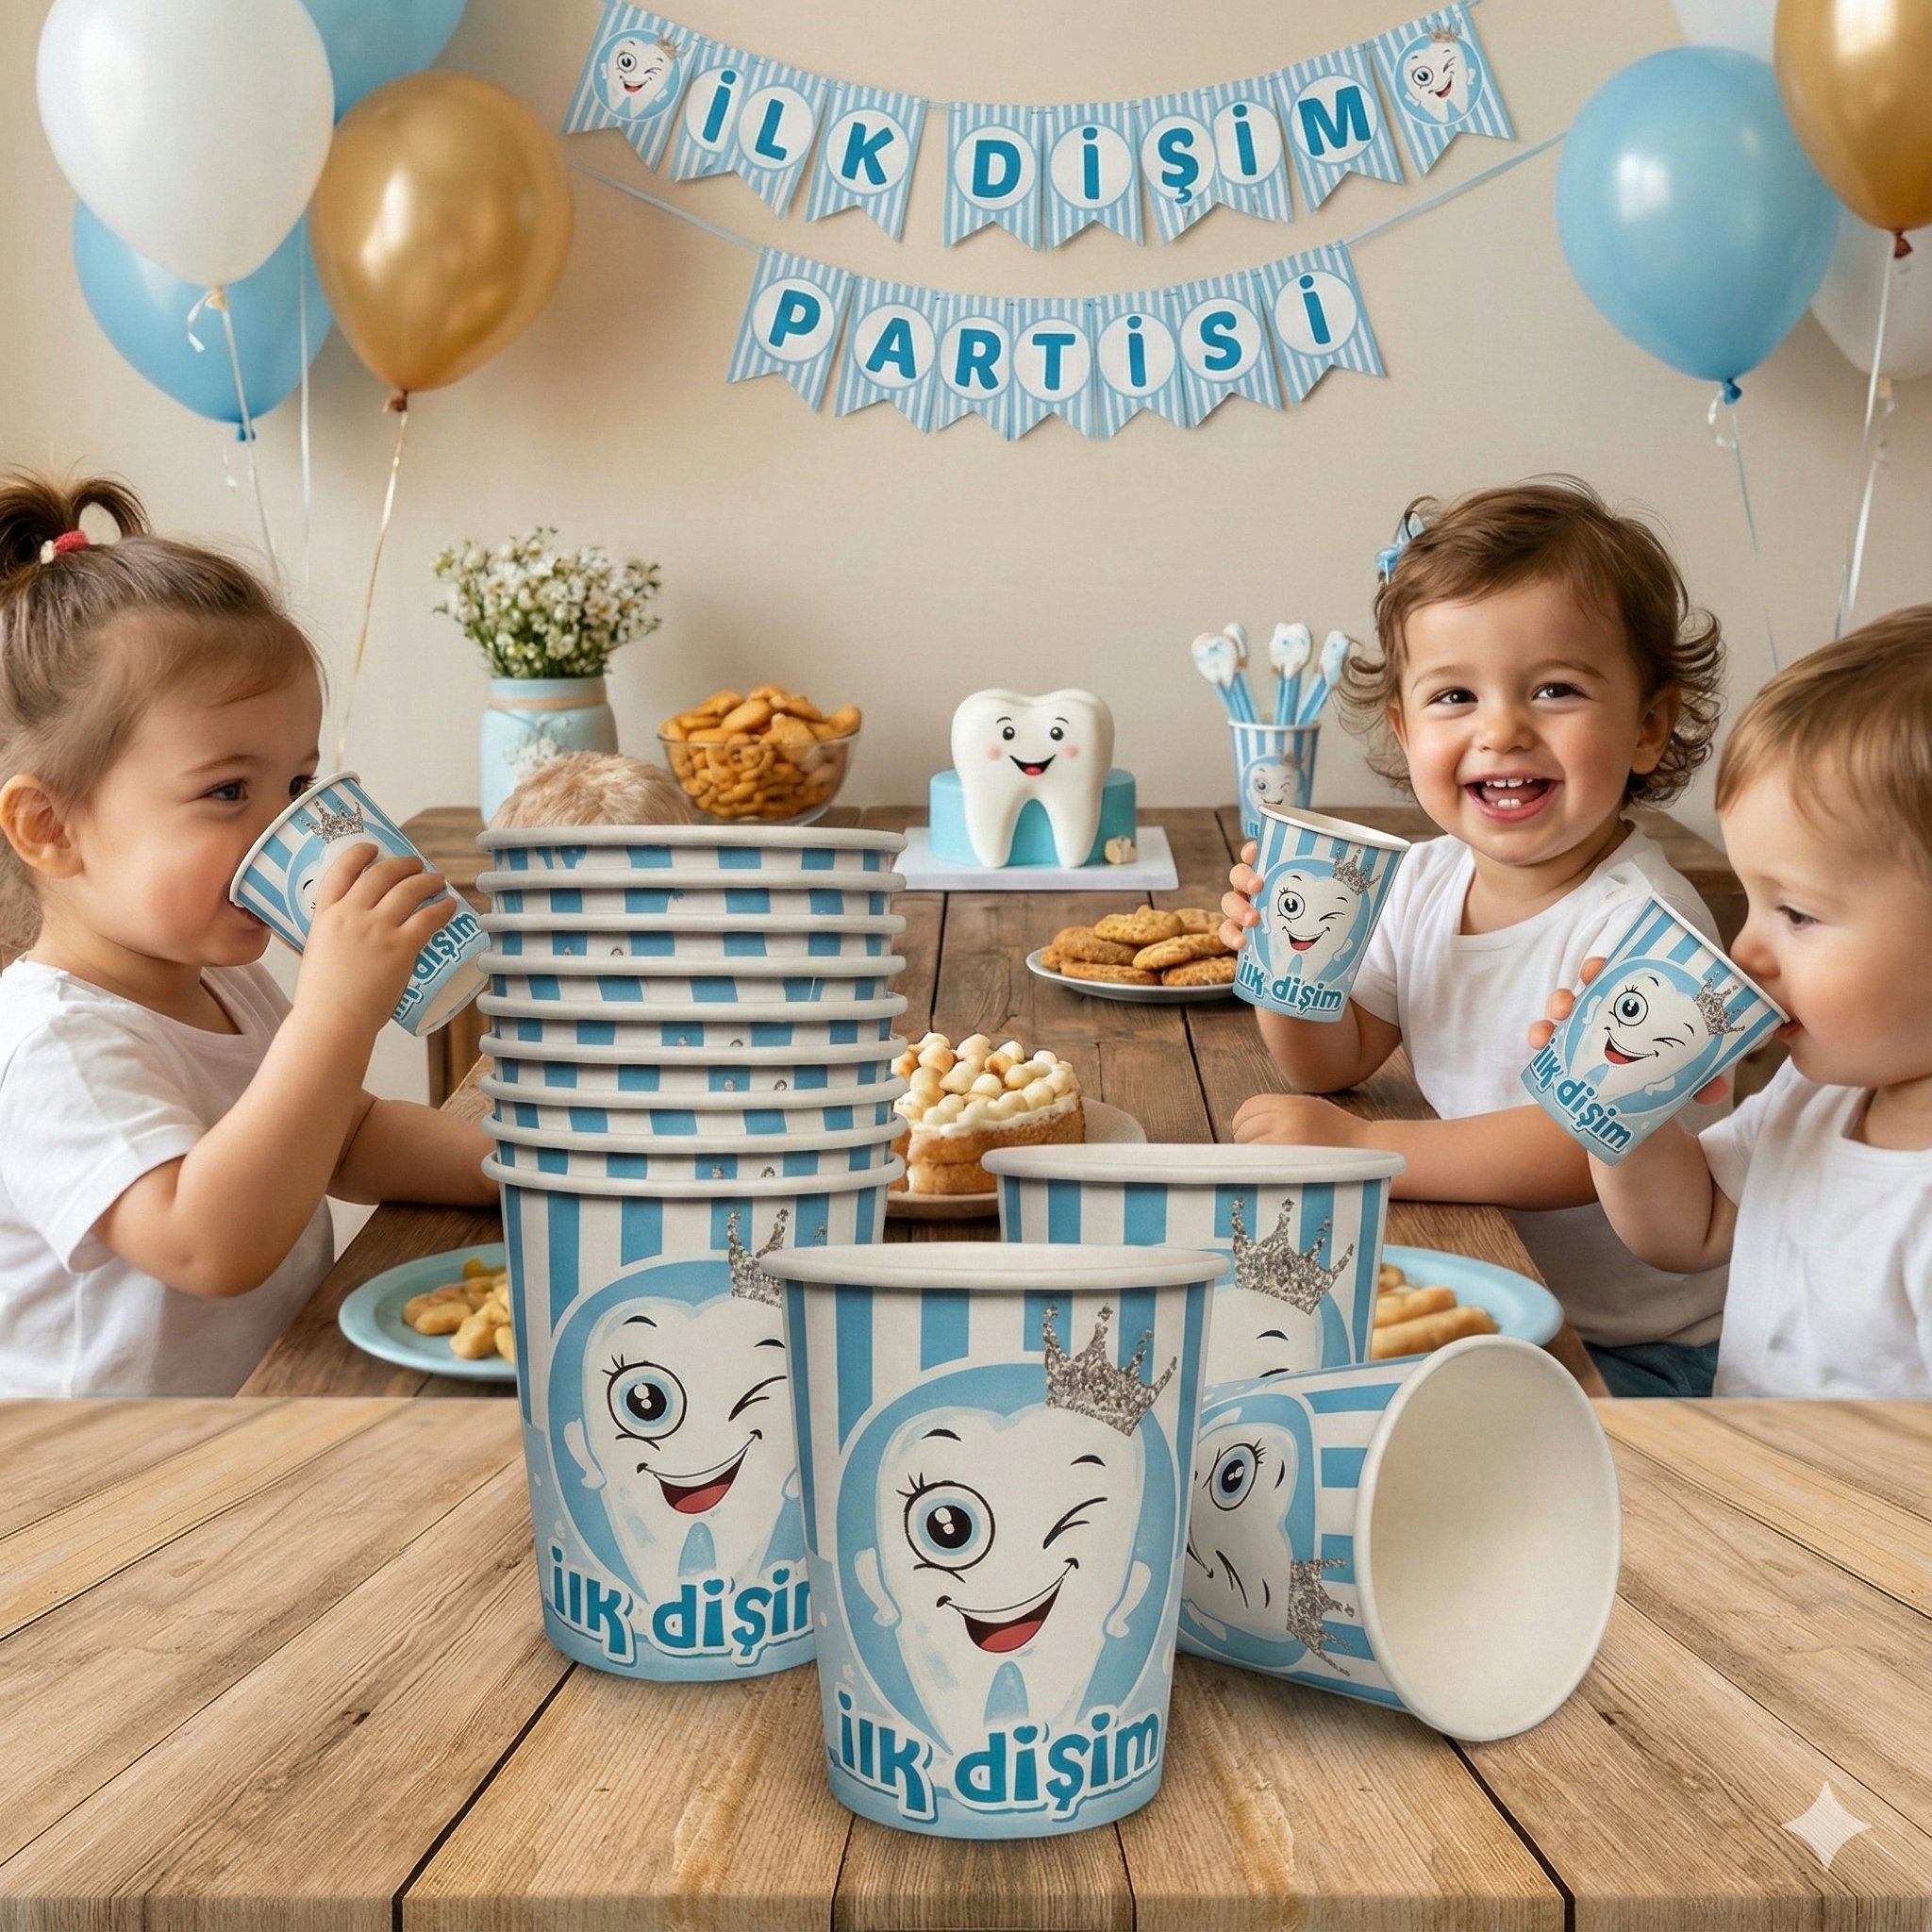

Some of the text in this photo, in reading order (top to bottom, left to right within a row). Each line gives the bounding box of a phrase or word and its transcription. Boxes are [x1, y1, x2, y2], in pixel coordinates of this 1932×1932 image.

[703, 70, 1373, 204] İLK DİŞİM
[768, 275, 1331, 391] PARTİSİ
[1239, 954, 1342, 1011] ilk dişim
[1532, 1037, 1632, 1149] ilk dişim
[551, 1544, 627, 1657] ilk
[837, 1689, 1160, 1814] ilk dişim
